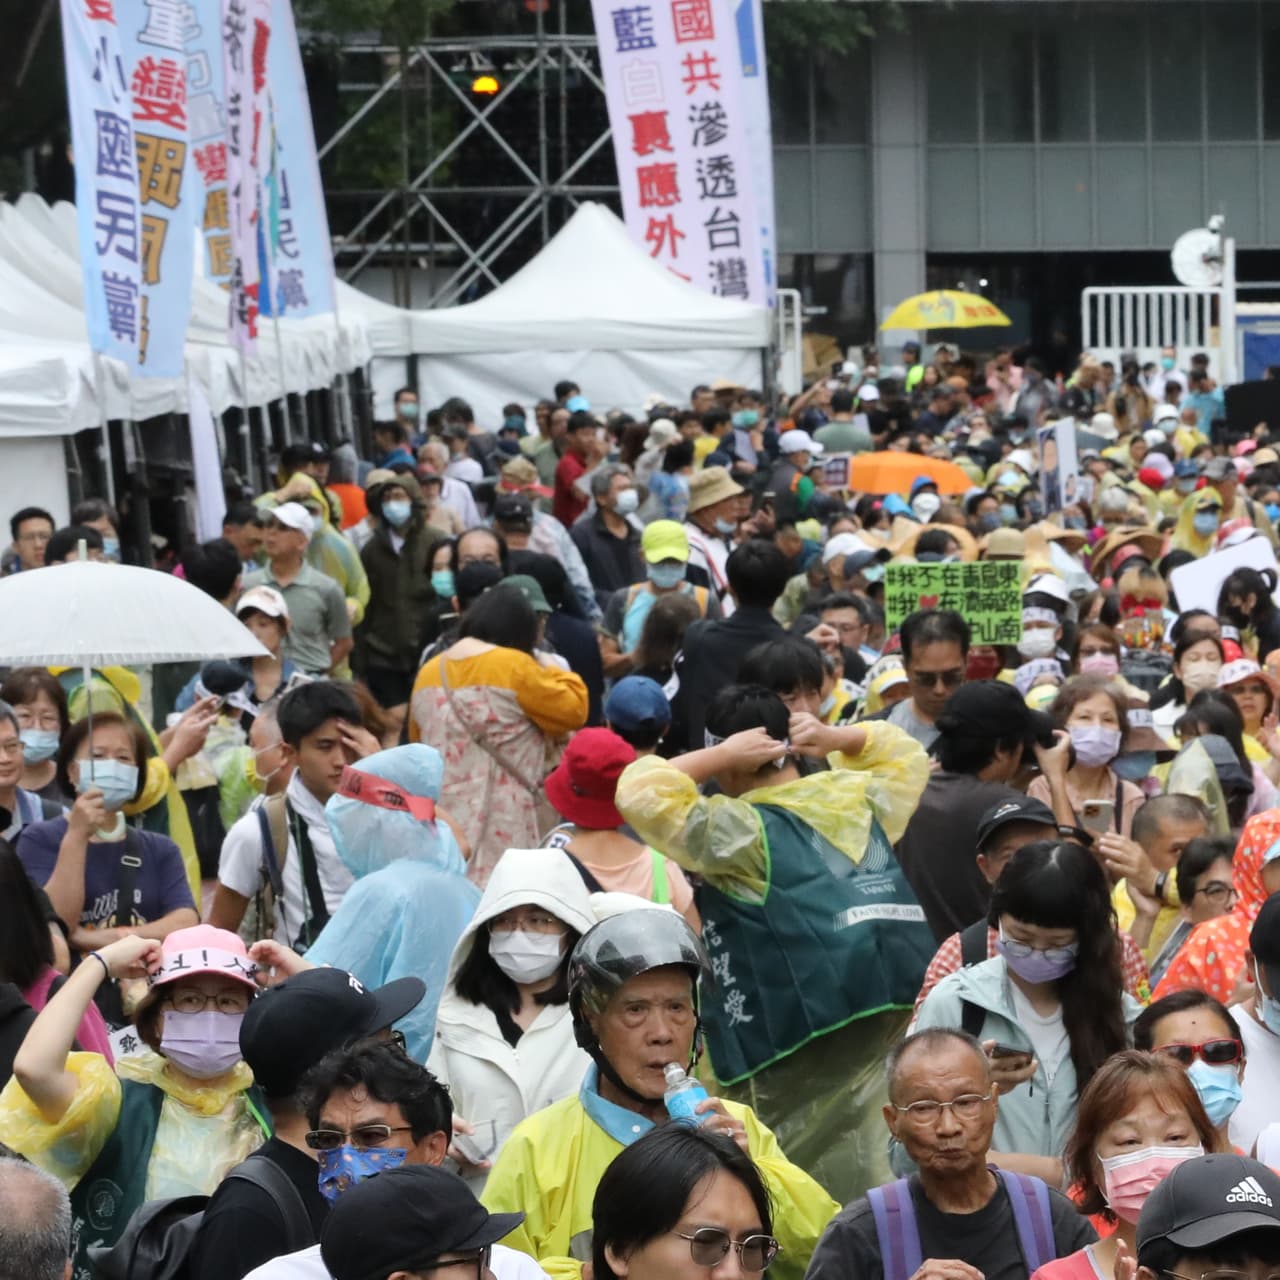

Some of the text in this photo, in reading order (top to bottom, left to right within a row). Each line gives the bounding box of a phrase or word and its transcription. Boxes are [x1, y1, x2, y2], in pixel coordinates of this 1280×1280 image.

[611, 5, 692, 282] 藍白裏應外
[671, 0, 749, 300] 國共滲透台灣
[1226, 1192, 1273, 1207] adidas
